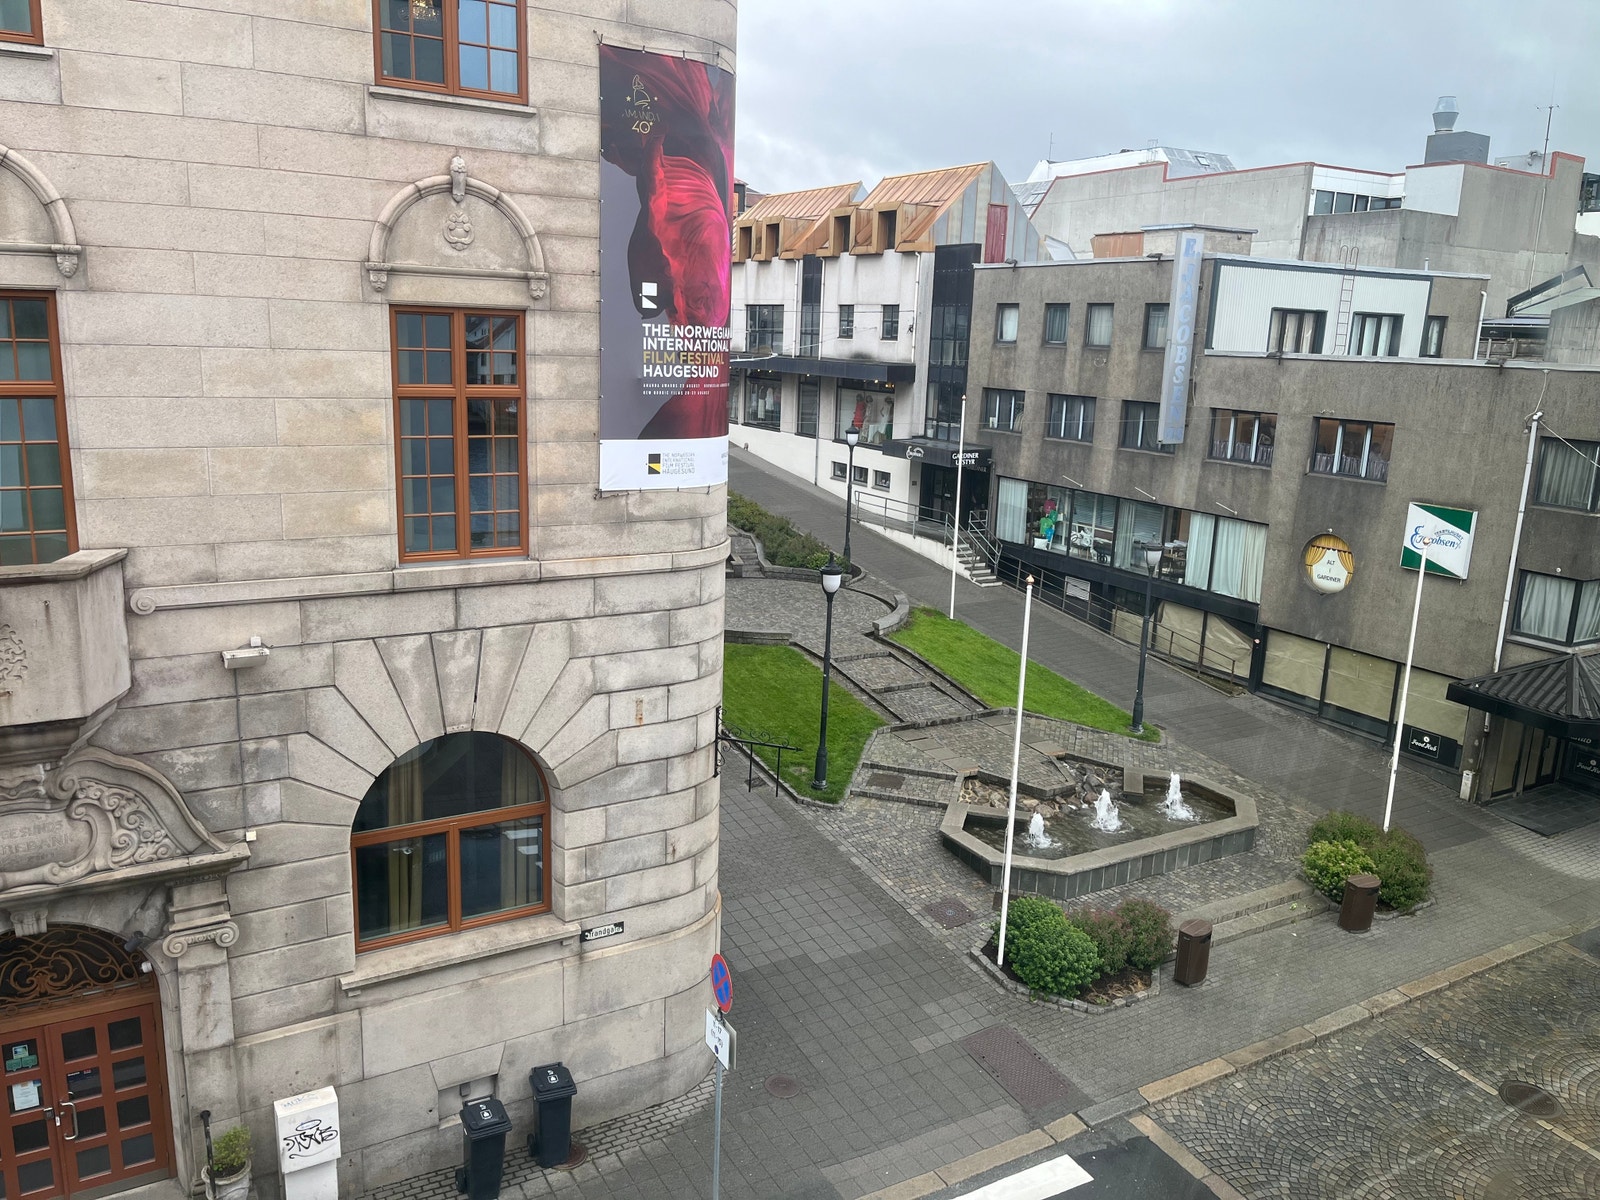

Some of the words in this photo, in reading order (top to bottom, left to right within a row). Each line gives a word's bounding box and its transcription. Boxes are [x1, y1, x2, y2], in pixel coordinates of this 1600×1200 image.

[642, 323, 670, 337] THE
[643, 337, 729, 352] INTERNATIONAL
[1170, 263, 1195, 422] JACOBSEN
[643, 351, 676, 364] FILM
[680, 351, 725, 365] FESTIVAL
[643, 364, 719, 378] HAUGESUND
[952, 452, 979, 460] GADINER
[1317, 573, 1342, 583] GARDINER
